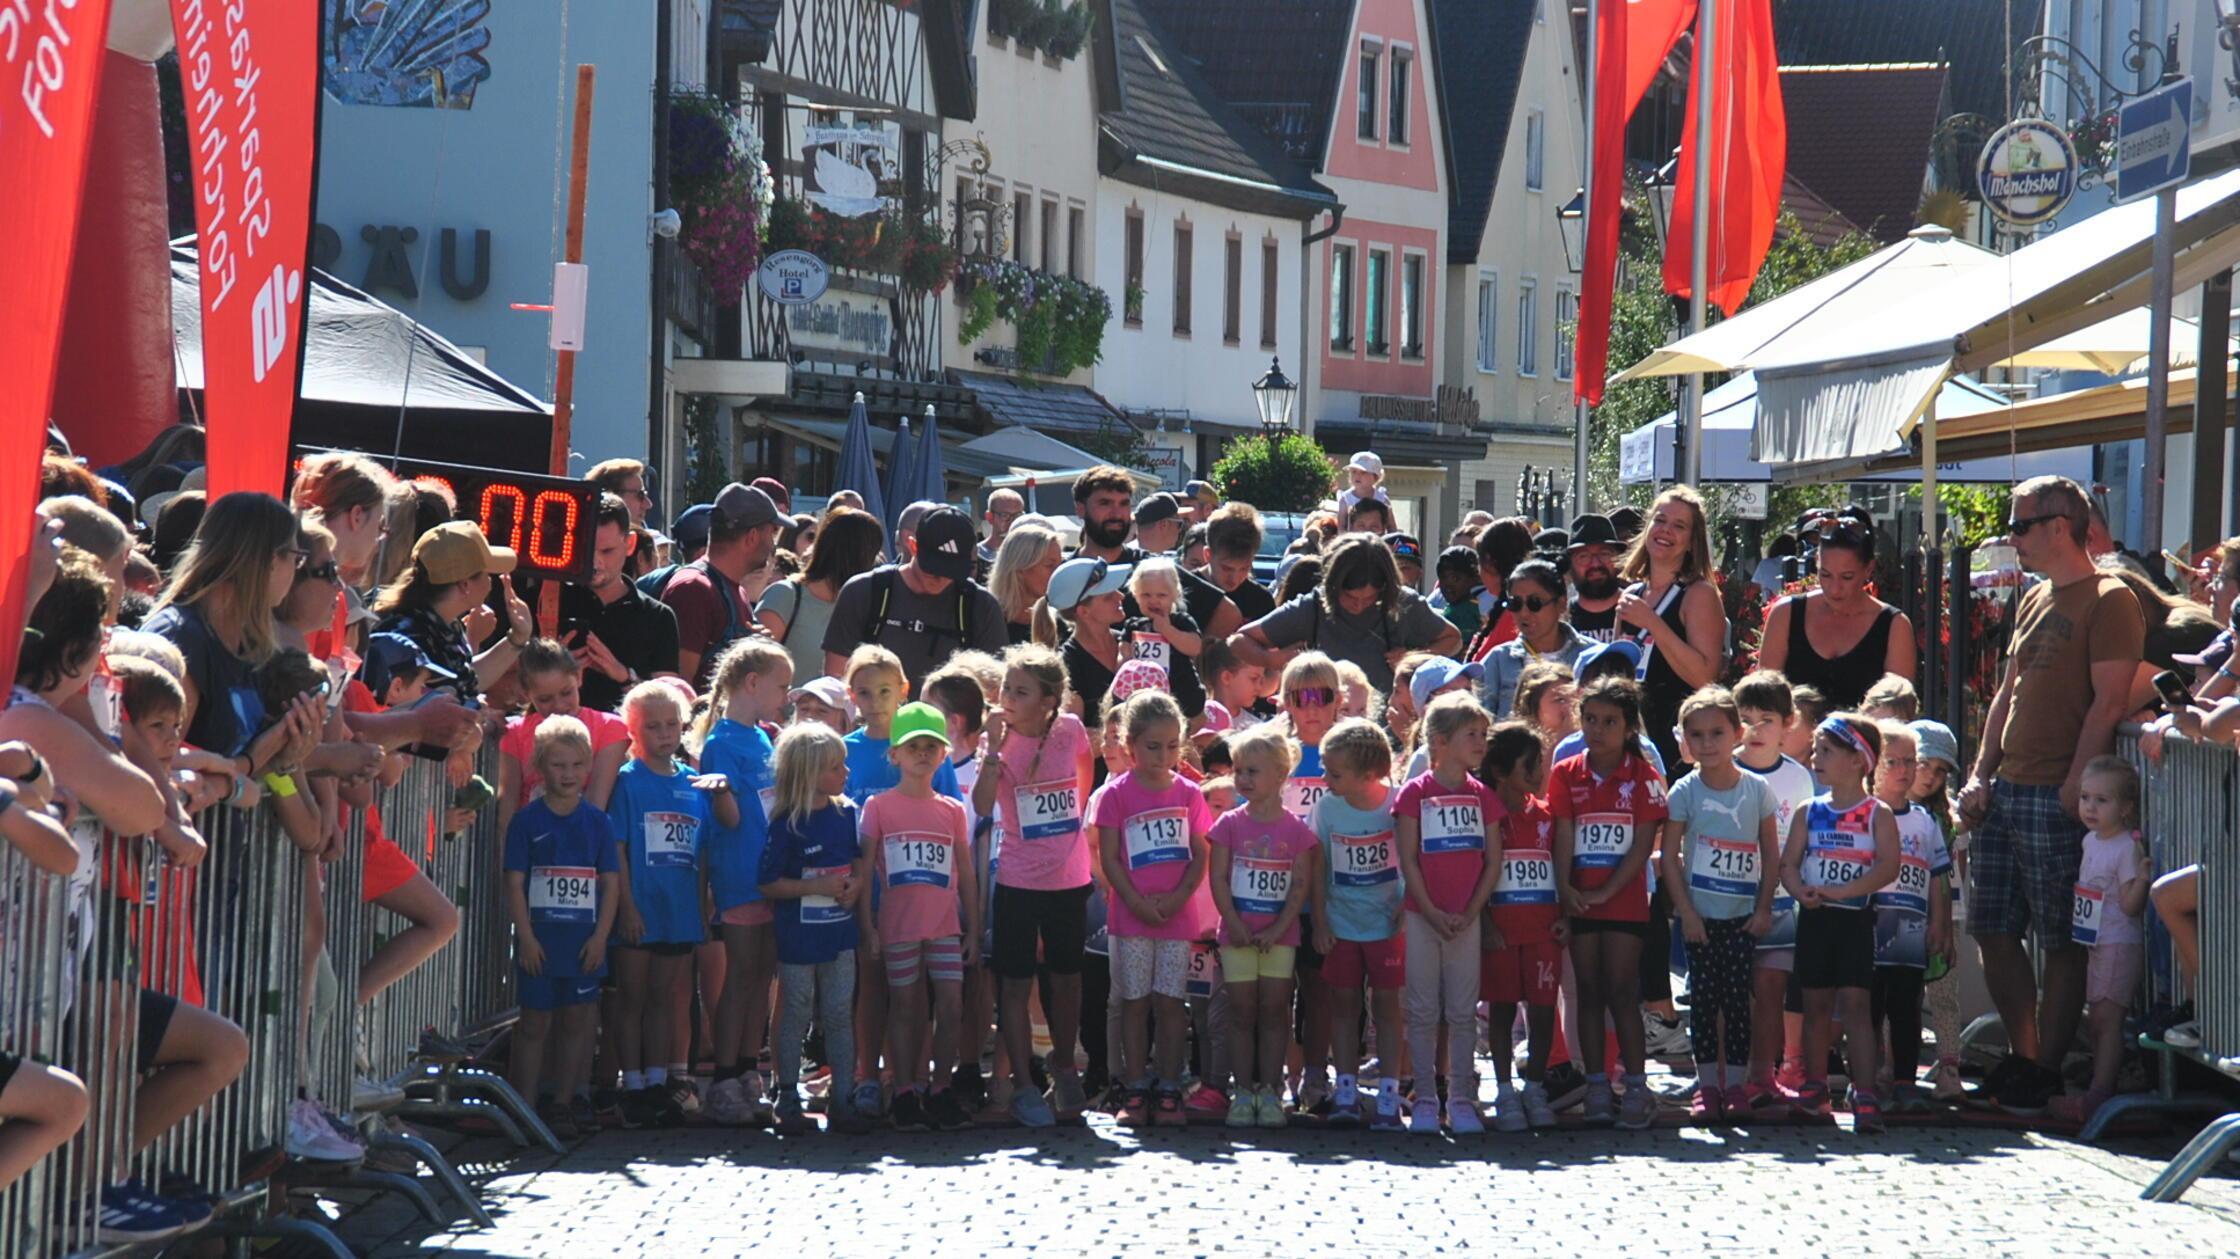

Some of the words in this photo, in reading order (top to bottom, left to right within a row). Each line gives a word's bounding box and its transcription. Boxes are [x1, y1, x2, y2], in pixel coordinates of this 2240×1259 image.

[22, 0, 76, 138] For
[778, 268, 809, 279] Hotel
[1035, 789, 1076, 815] 2006
[1437, 806, 1478, 828] 1104
[1142, 818, 1183, 841] 1137
[1580, 824, 1625, 844] 1979
[902, 841, 945, 864] 1139
[1346, 841, 1389, 868] 1826
[1710, 848, 1754, 873] 2115
[1247, 869, 1287, 892] 1805
[1504, 860, 1548, 881] 1980
[1818, 858, 1864, 882] 1864
[546, 877, 590, 899] 1994
